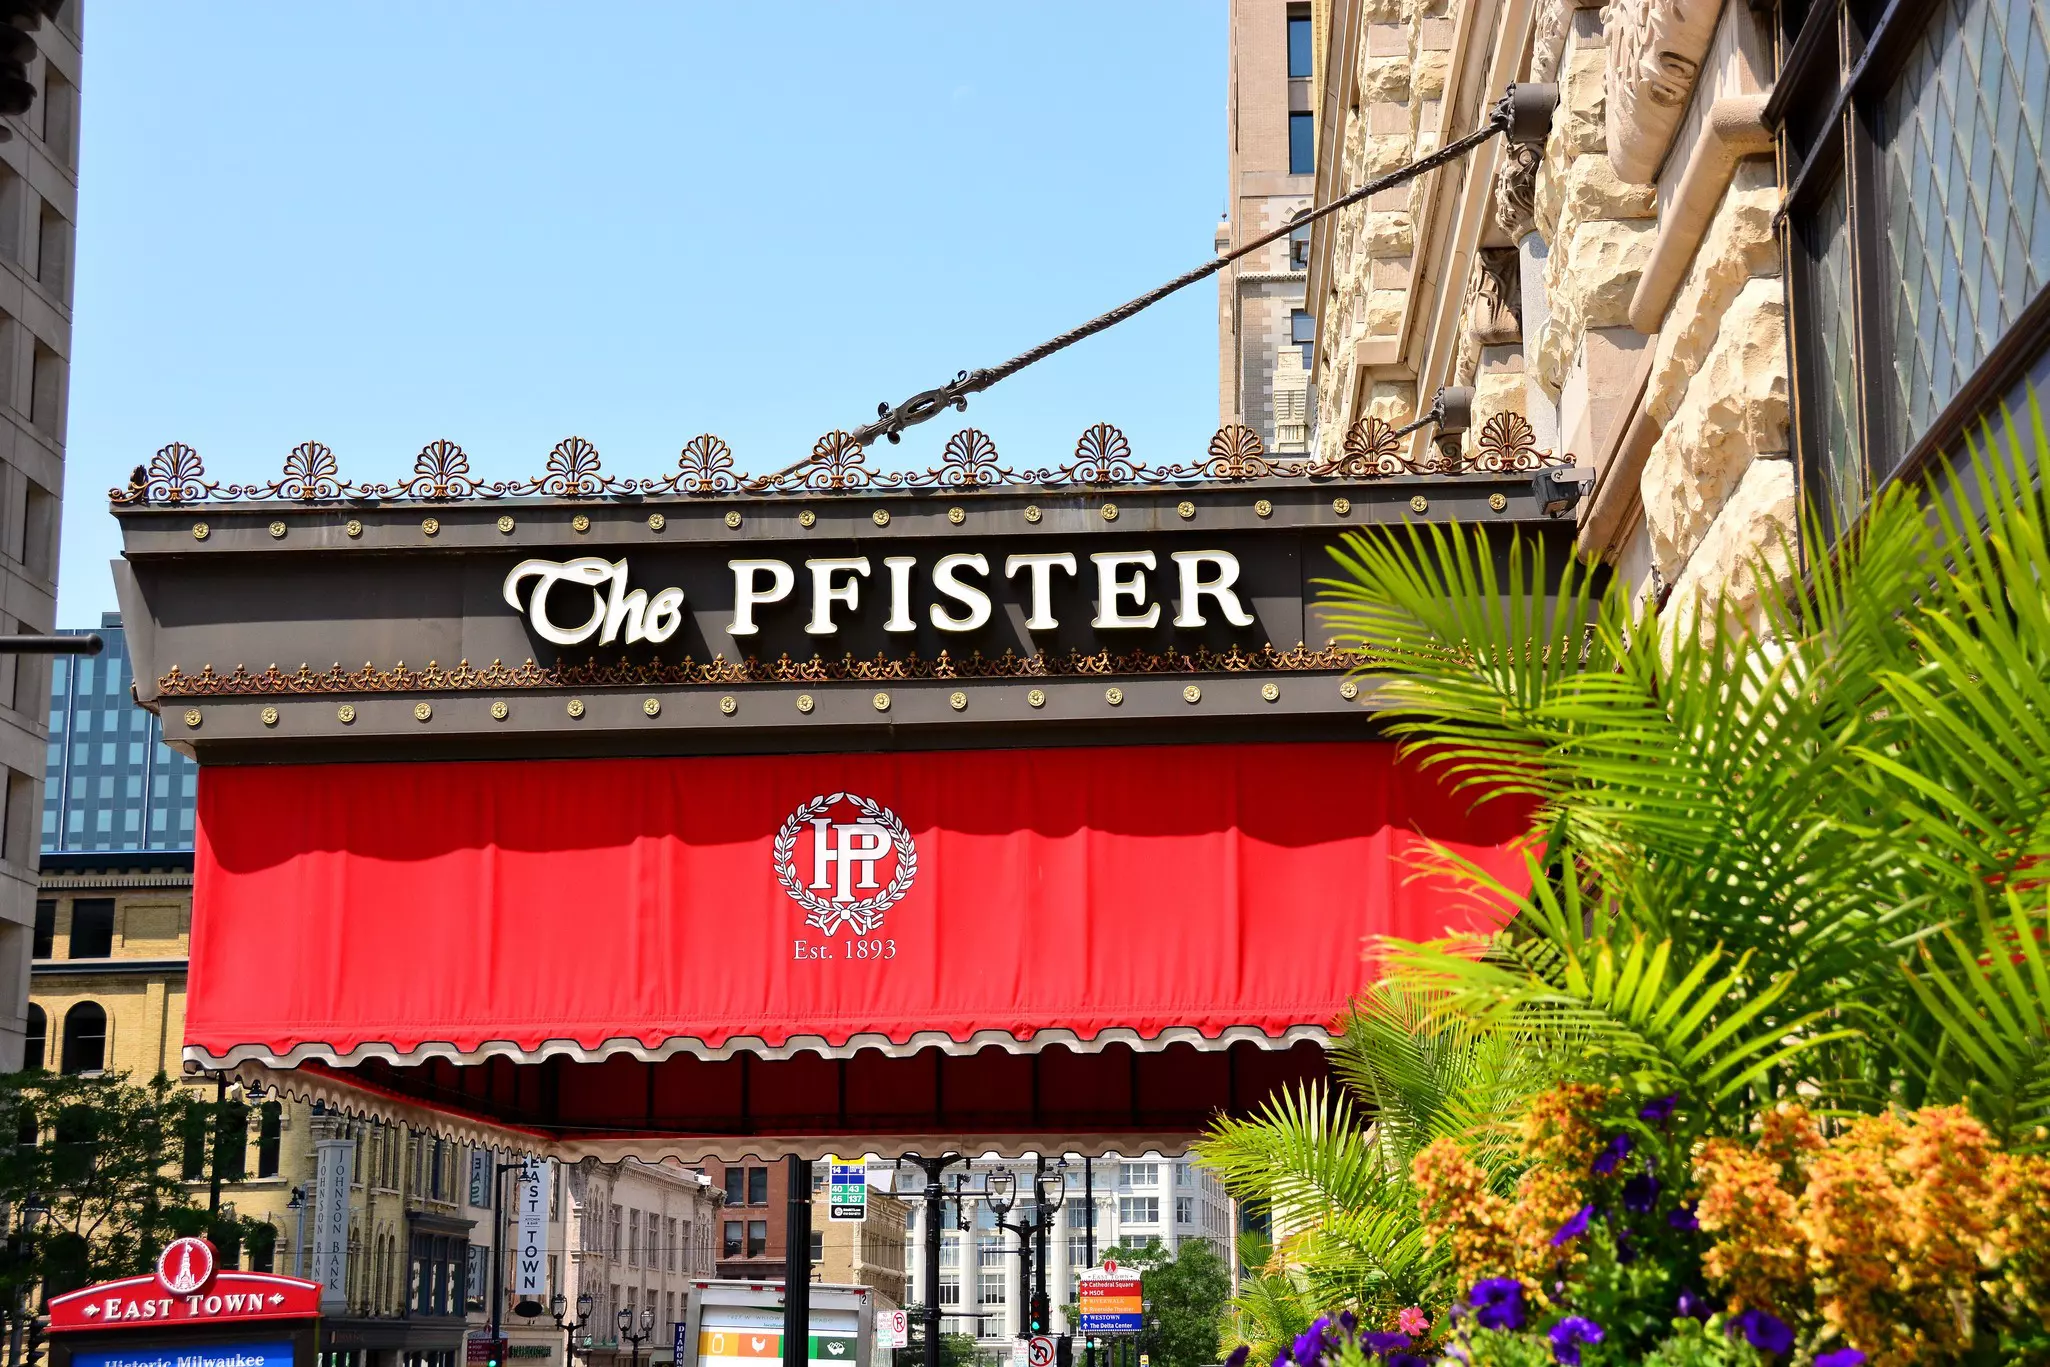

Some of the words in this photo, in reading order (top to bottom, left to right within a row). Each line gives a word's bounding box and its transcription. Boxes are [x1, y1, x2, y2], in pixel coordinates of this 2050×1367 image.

[504, 558, 684, 645] The
[726, 551, 1255, 636] PFISTER
[794, 940, 833, 959] Est.
[846, 940, 895, 959] 1893
[529, 1157, 541, 1212] EAST
[832, 1166, 841, 1174] 14
[317, 1149, 327, 1235] JOHNSON
[332, 1149, 345, 1235] JOHNSON
[329, 1241, 340, 1290] BANK
[522, 1230, 539, 1289] TOWN
[861, 1295, 867, 1305] 2
[1115, 1281, 1134, 1289] Square
[104, 1298, 173, 1320] EAST
[186, 1293, 264, 1316] TOWN
[177, 1353, 265, 1367] Milwaukee
[676, 1325, 685, 1367] DIAMON
